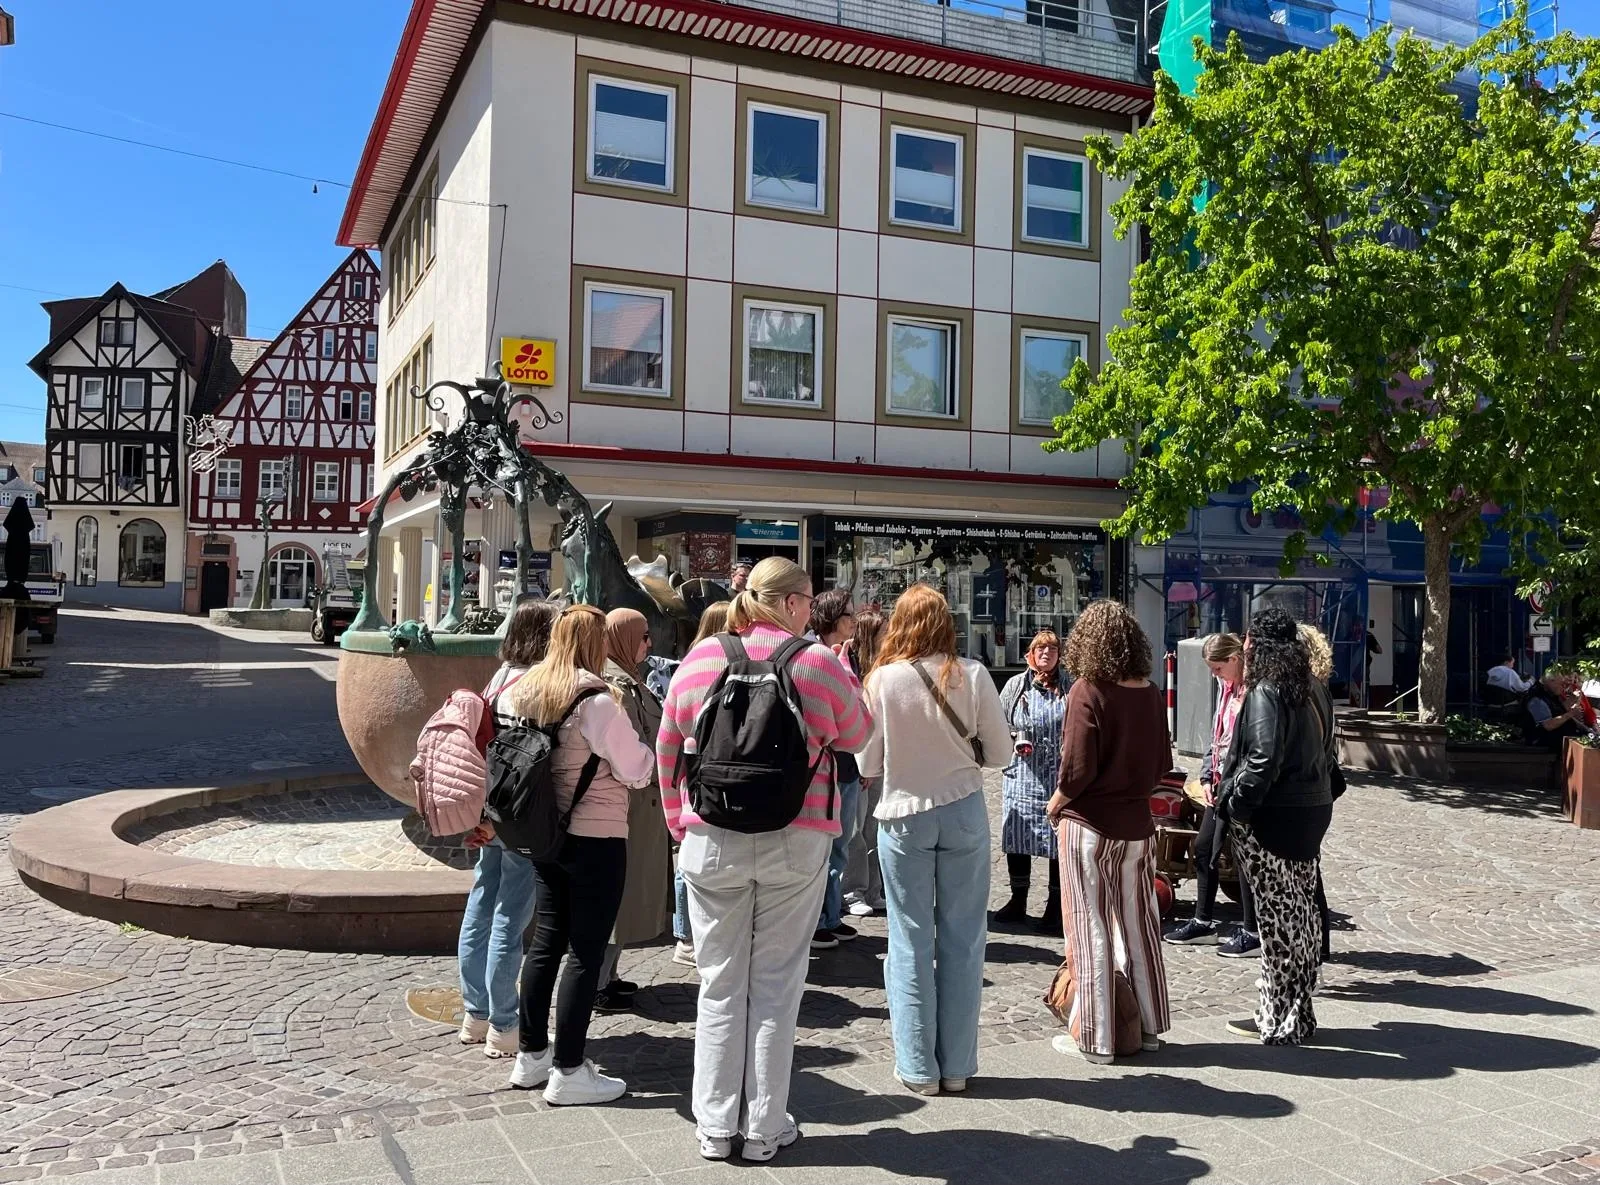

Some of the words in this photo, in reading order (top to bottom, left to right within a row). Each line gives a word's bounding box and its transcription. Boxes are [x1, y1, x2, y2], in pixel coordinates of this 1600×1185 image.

[507, 367, 548, 380] LOTTO
[758, 528, 784, 536] Hermes
[834, 521, 851, 532] Tabak
[855, 522, 874, 533] Pfeifen
[875, 524, 885, 533] und
[886, 524, 907, 534] Zubehör
[911, 525, 932, 537] Zigarren
[936, 526, 962, 538] Zigaretten
[966, 527, 996, 538] Shishatabak
[999, 528, 1020, 538] E-Shisha
[1024, 529, 1046, 540] Getränke
[1050, 530, 1079, 540] Zeitschriften
